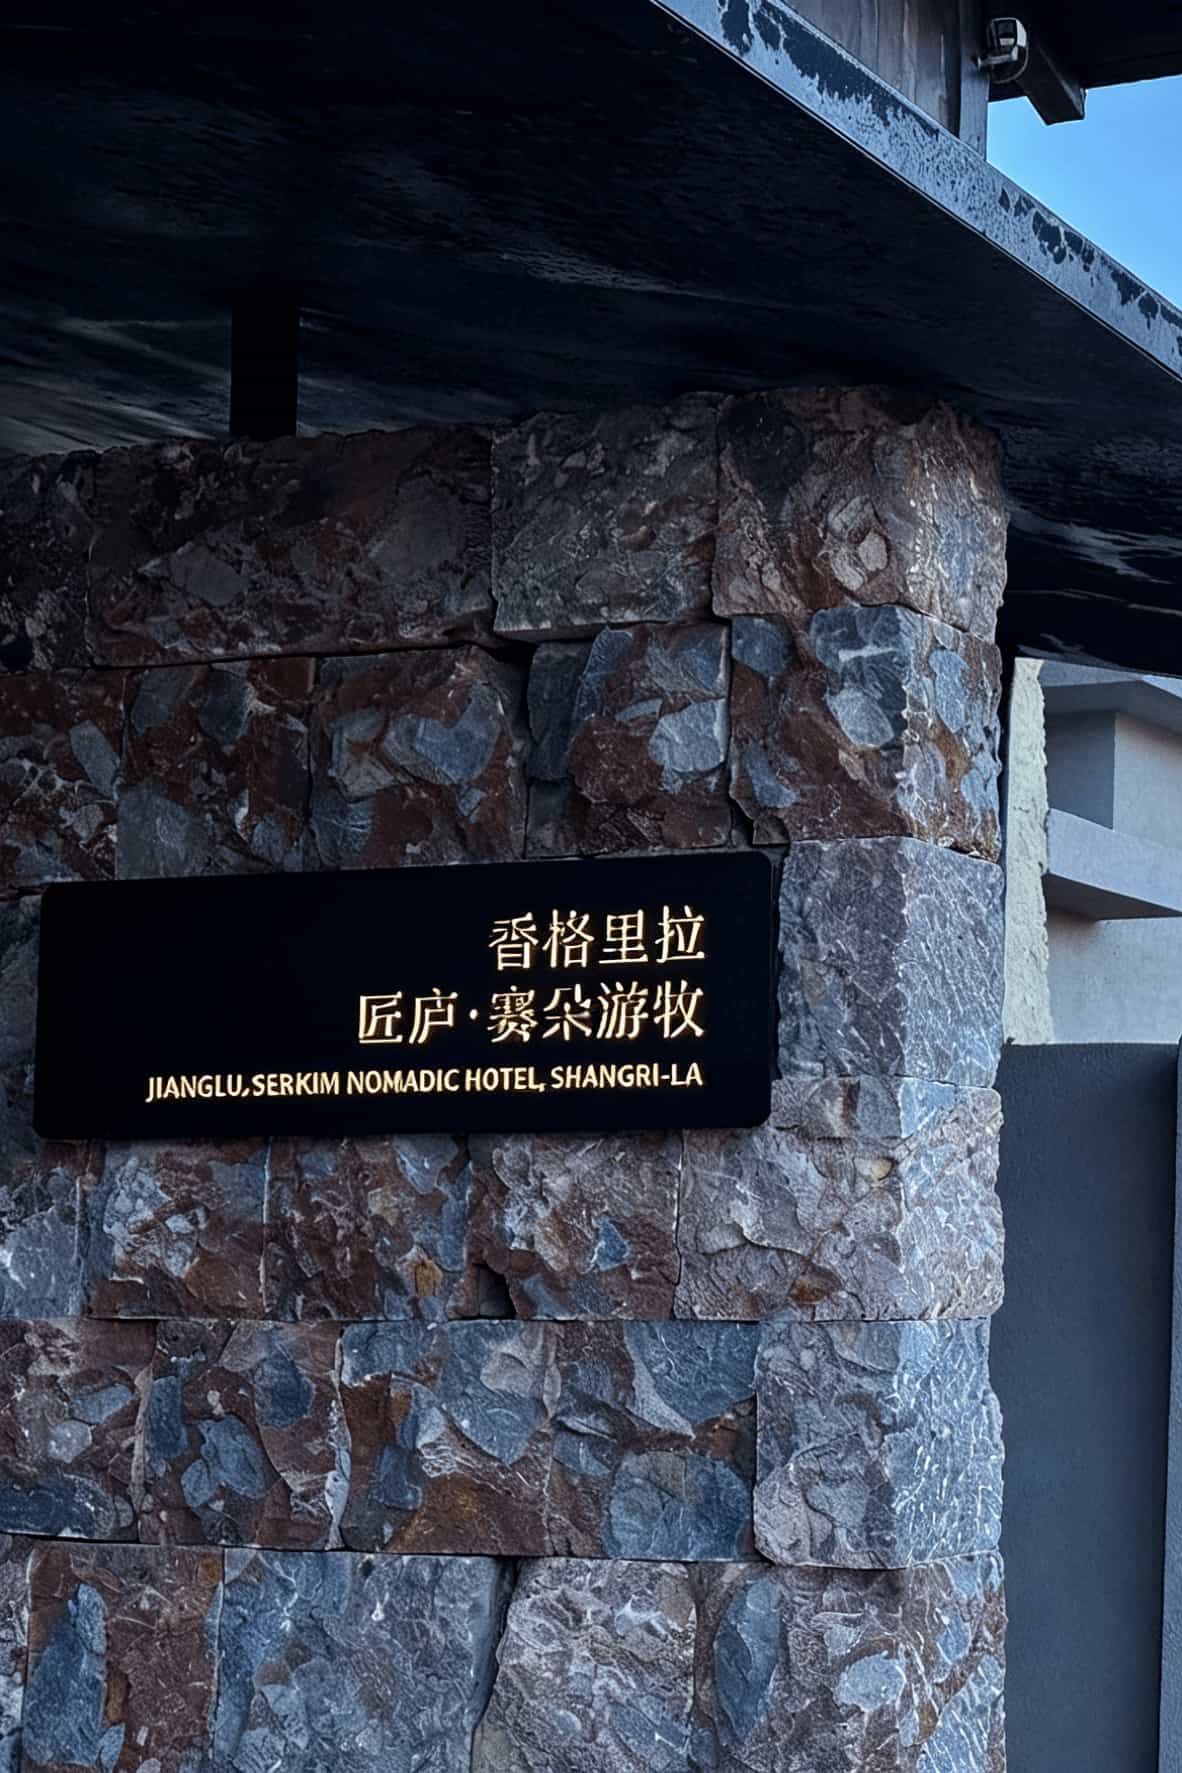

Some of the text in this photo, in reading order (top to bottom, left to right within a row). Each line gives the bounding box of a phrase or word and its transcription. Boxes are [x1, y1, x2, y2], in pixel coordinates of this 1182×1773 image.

[488, 904, 706, 971] 香格里拉
[345, 1068, 461, 1095] NOMADIC
[463, 1066, 547, 1093] HOTEL,
[549, 1062, 705, 1090] SHANGRI-LA
